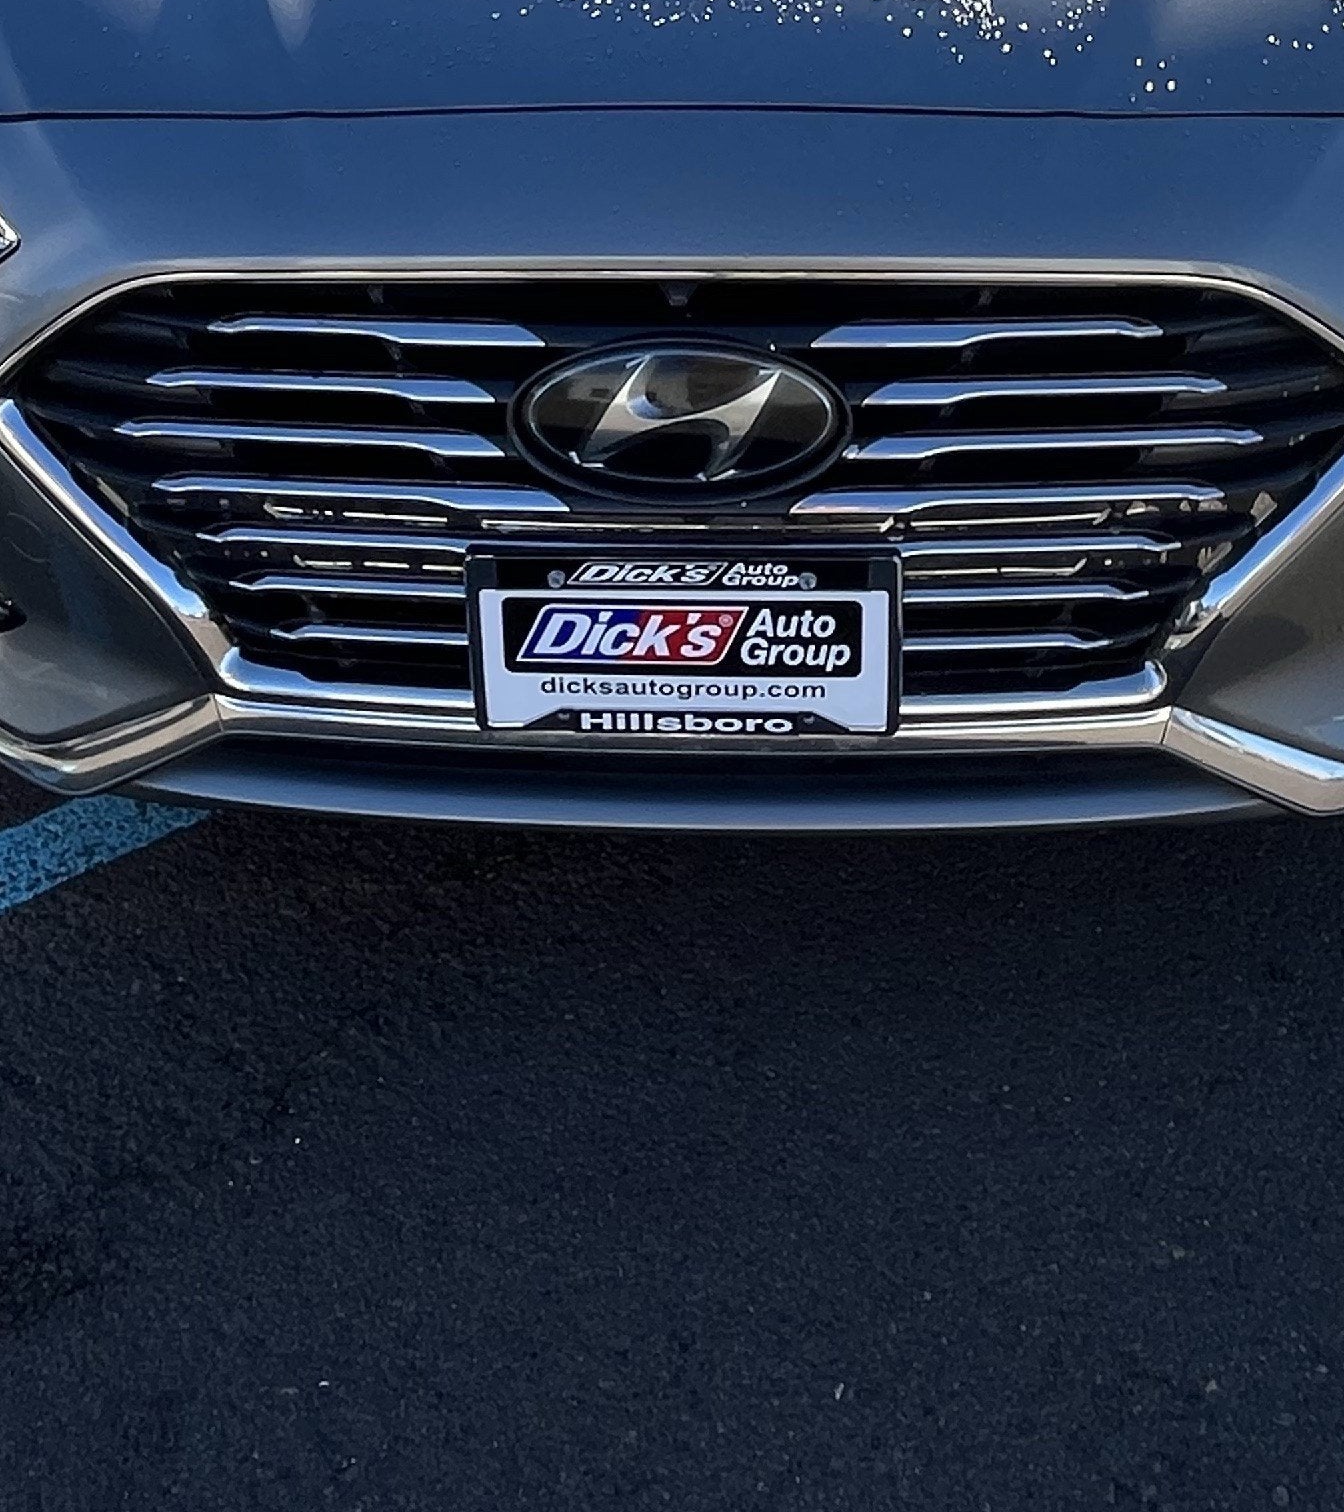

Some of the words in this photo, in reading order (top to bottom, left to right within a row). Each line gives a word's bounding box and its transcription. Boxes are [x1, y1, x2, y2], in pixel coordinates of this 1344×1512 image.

[578, 562, 710, 583] Dick's
[731, 562, 788, 576] Auto
[723, 573, 799, 588] Group
[533, 611, 722, 658] Dick's
[746, 608, 836, 639] Auto
[740, 638, 851, 672] Group
[540, 677, 826, 700] dicksautogroup.com
[580, 712, 794, 733] Hillsboro
